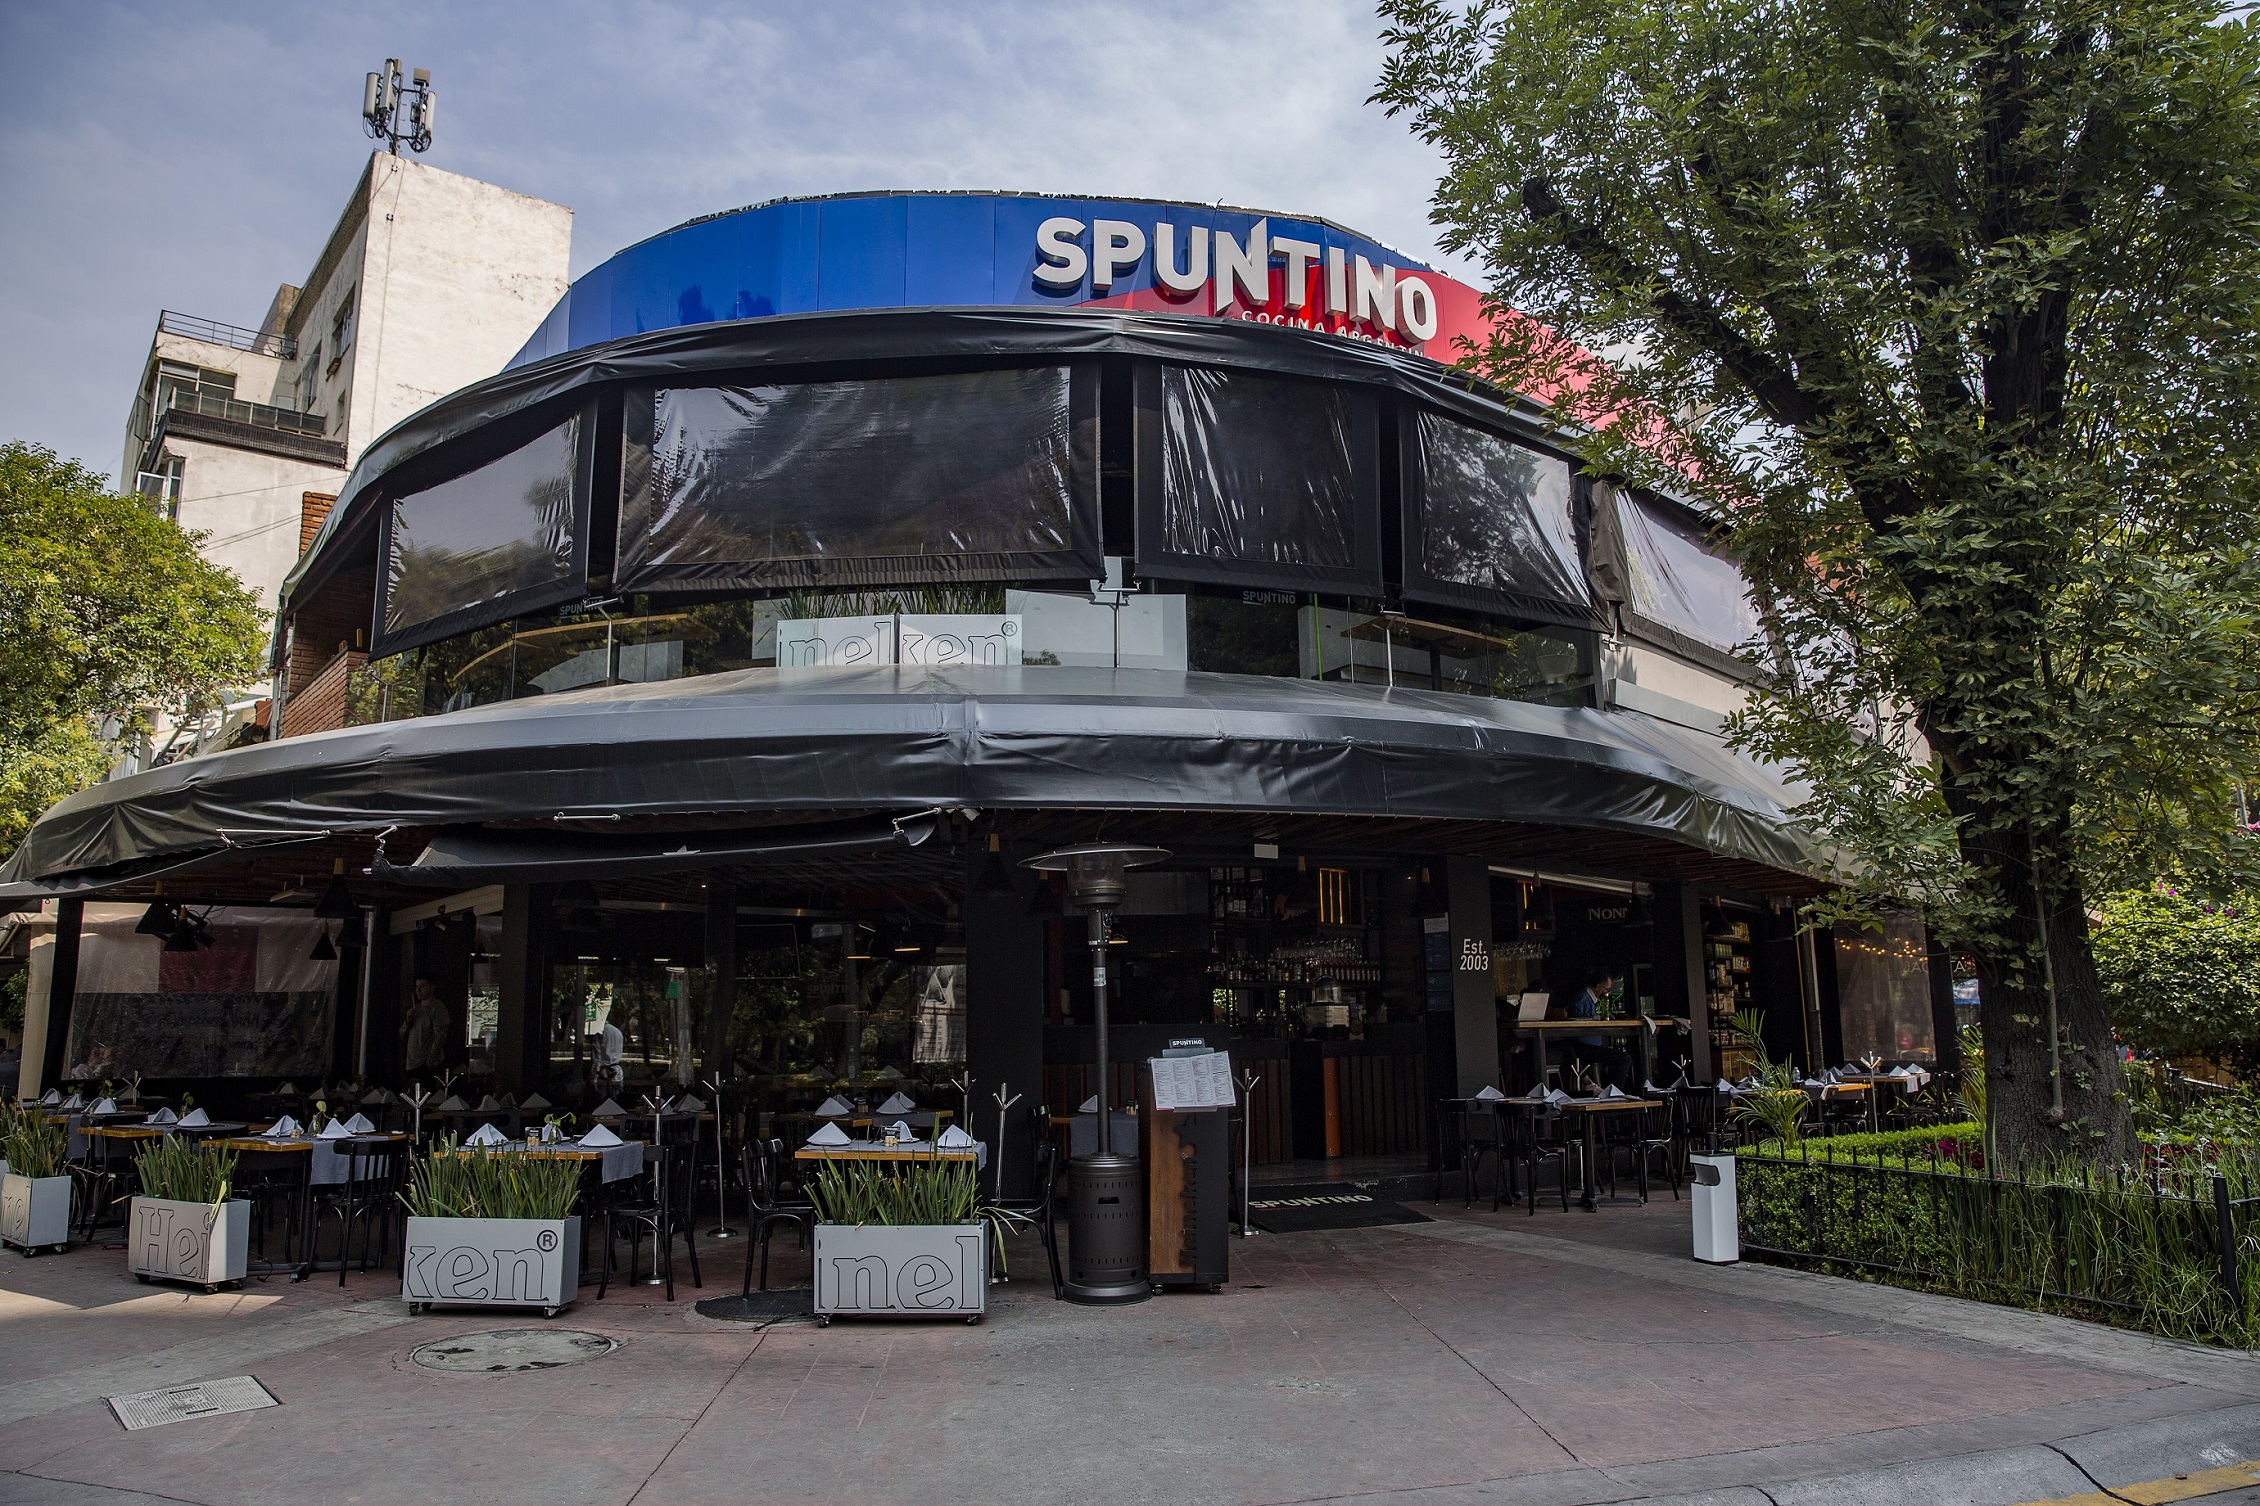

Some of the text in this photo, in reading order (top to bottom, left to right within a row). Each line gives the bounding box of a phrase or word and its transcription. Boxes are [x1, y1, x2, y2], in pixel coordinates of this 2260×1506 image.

[1032, 216, 1438, 344] SPUNTINO
[1241, 309, 1326, 334] COCINA
[1242, 590, 1296, 604] SPUNTINO
[1463, 938, 1487, 954] Est.
[1460, 955, 1489, 971] 2003
[1172, 1039, 1203, 1047] SPUNTINO
[1248, 1194, 1373, 1208] SPUNTINO
